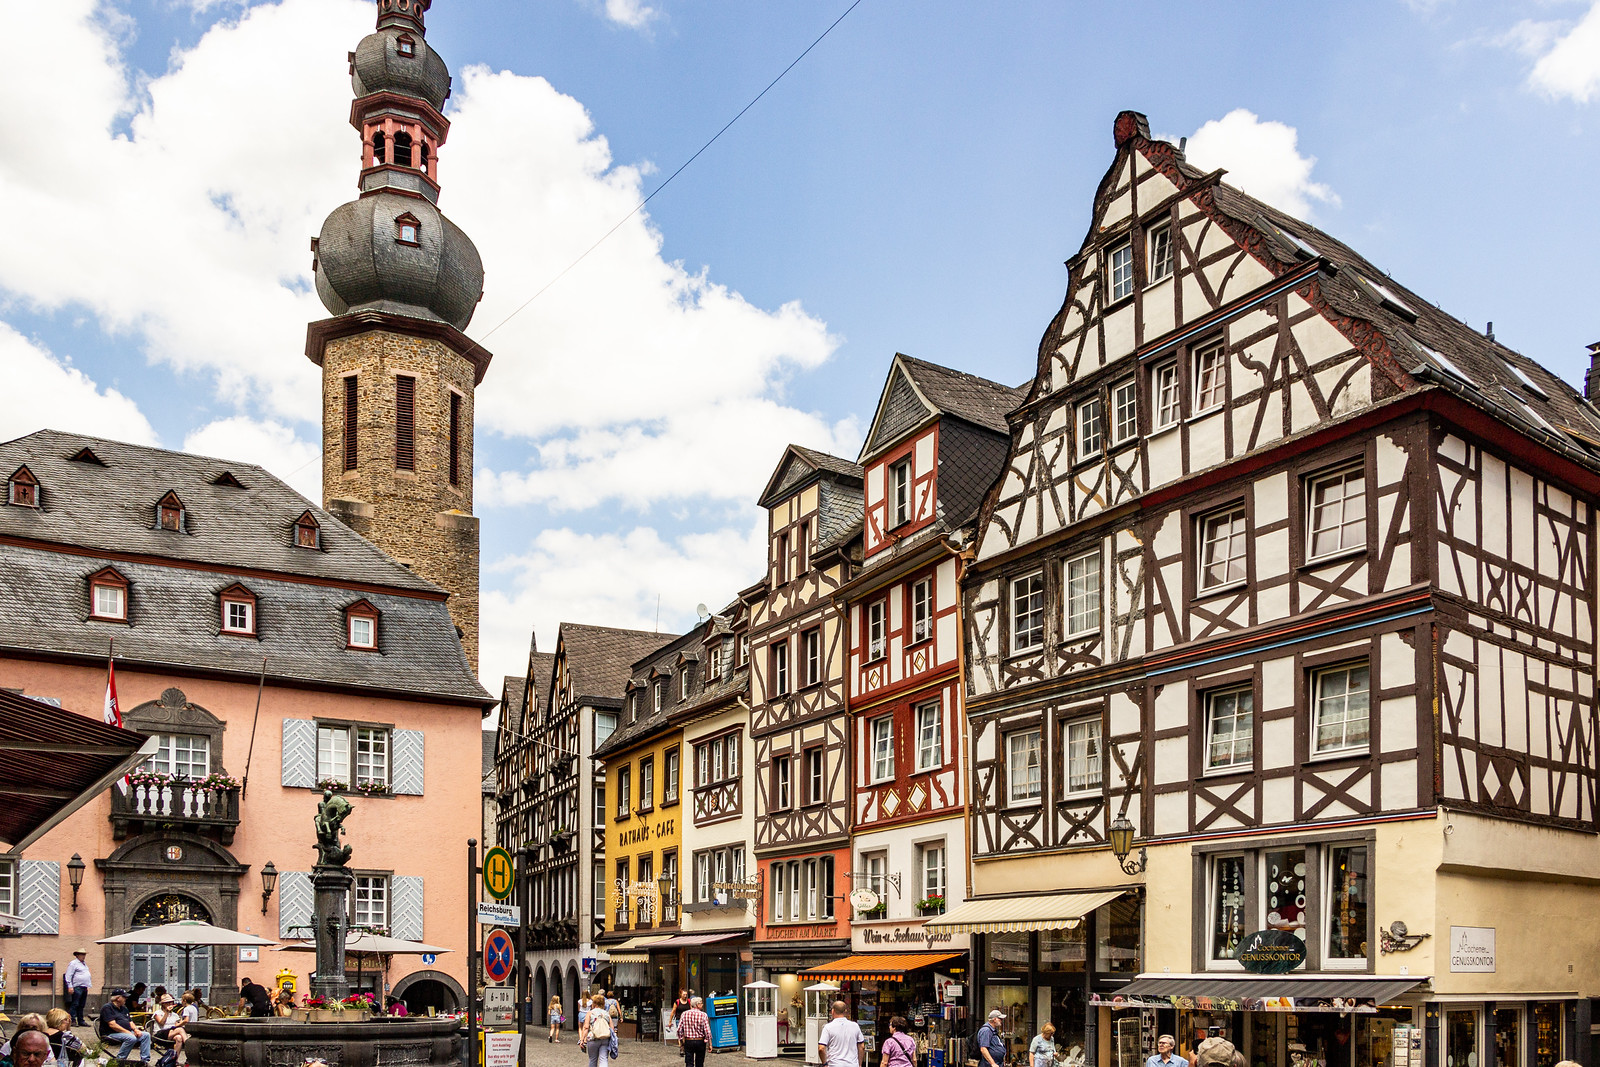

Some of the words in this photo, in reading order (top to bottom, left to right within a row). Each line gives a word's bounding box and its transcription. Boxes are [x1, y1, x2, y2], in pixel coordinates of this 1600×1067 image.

[619, 826, 650, 847] RATHAUS
[656, 818, 675, 838] CAFE
[493, 858, 505, 889] H
[479, 903, 513, 917] Reichsburg
[494, 914, 519, 923] Shuttle-Bus
[799, 927, 810, 938] AM
[811, 925, 838, 938] MARKT
[1257, 943, 1289, 952] Cochemer
[1241, 953, 1301, 961] GENUSSKONTOR
[1452, 956, 1494, 966] GENUSSKONTOR
[490, 992, 494, 1001] 6
[1196, 1002, 1232, 1010] WEINGUT
[1236, 1003, 1256, 1011] RING
